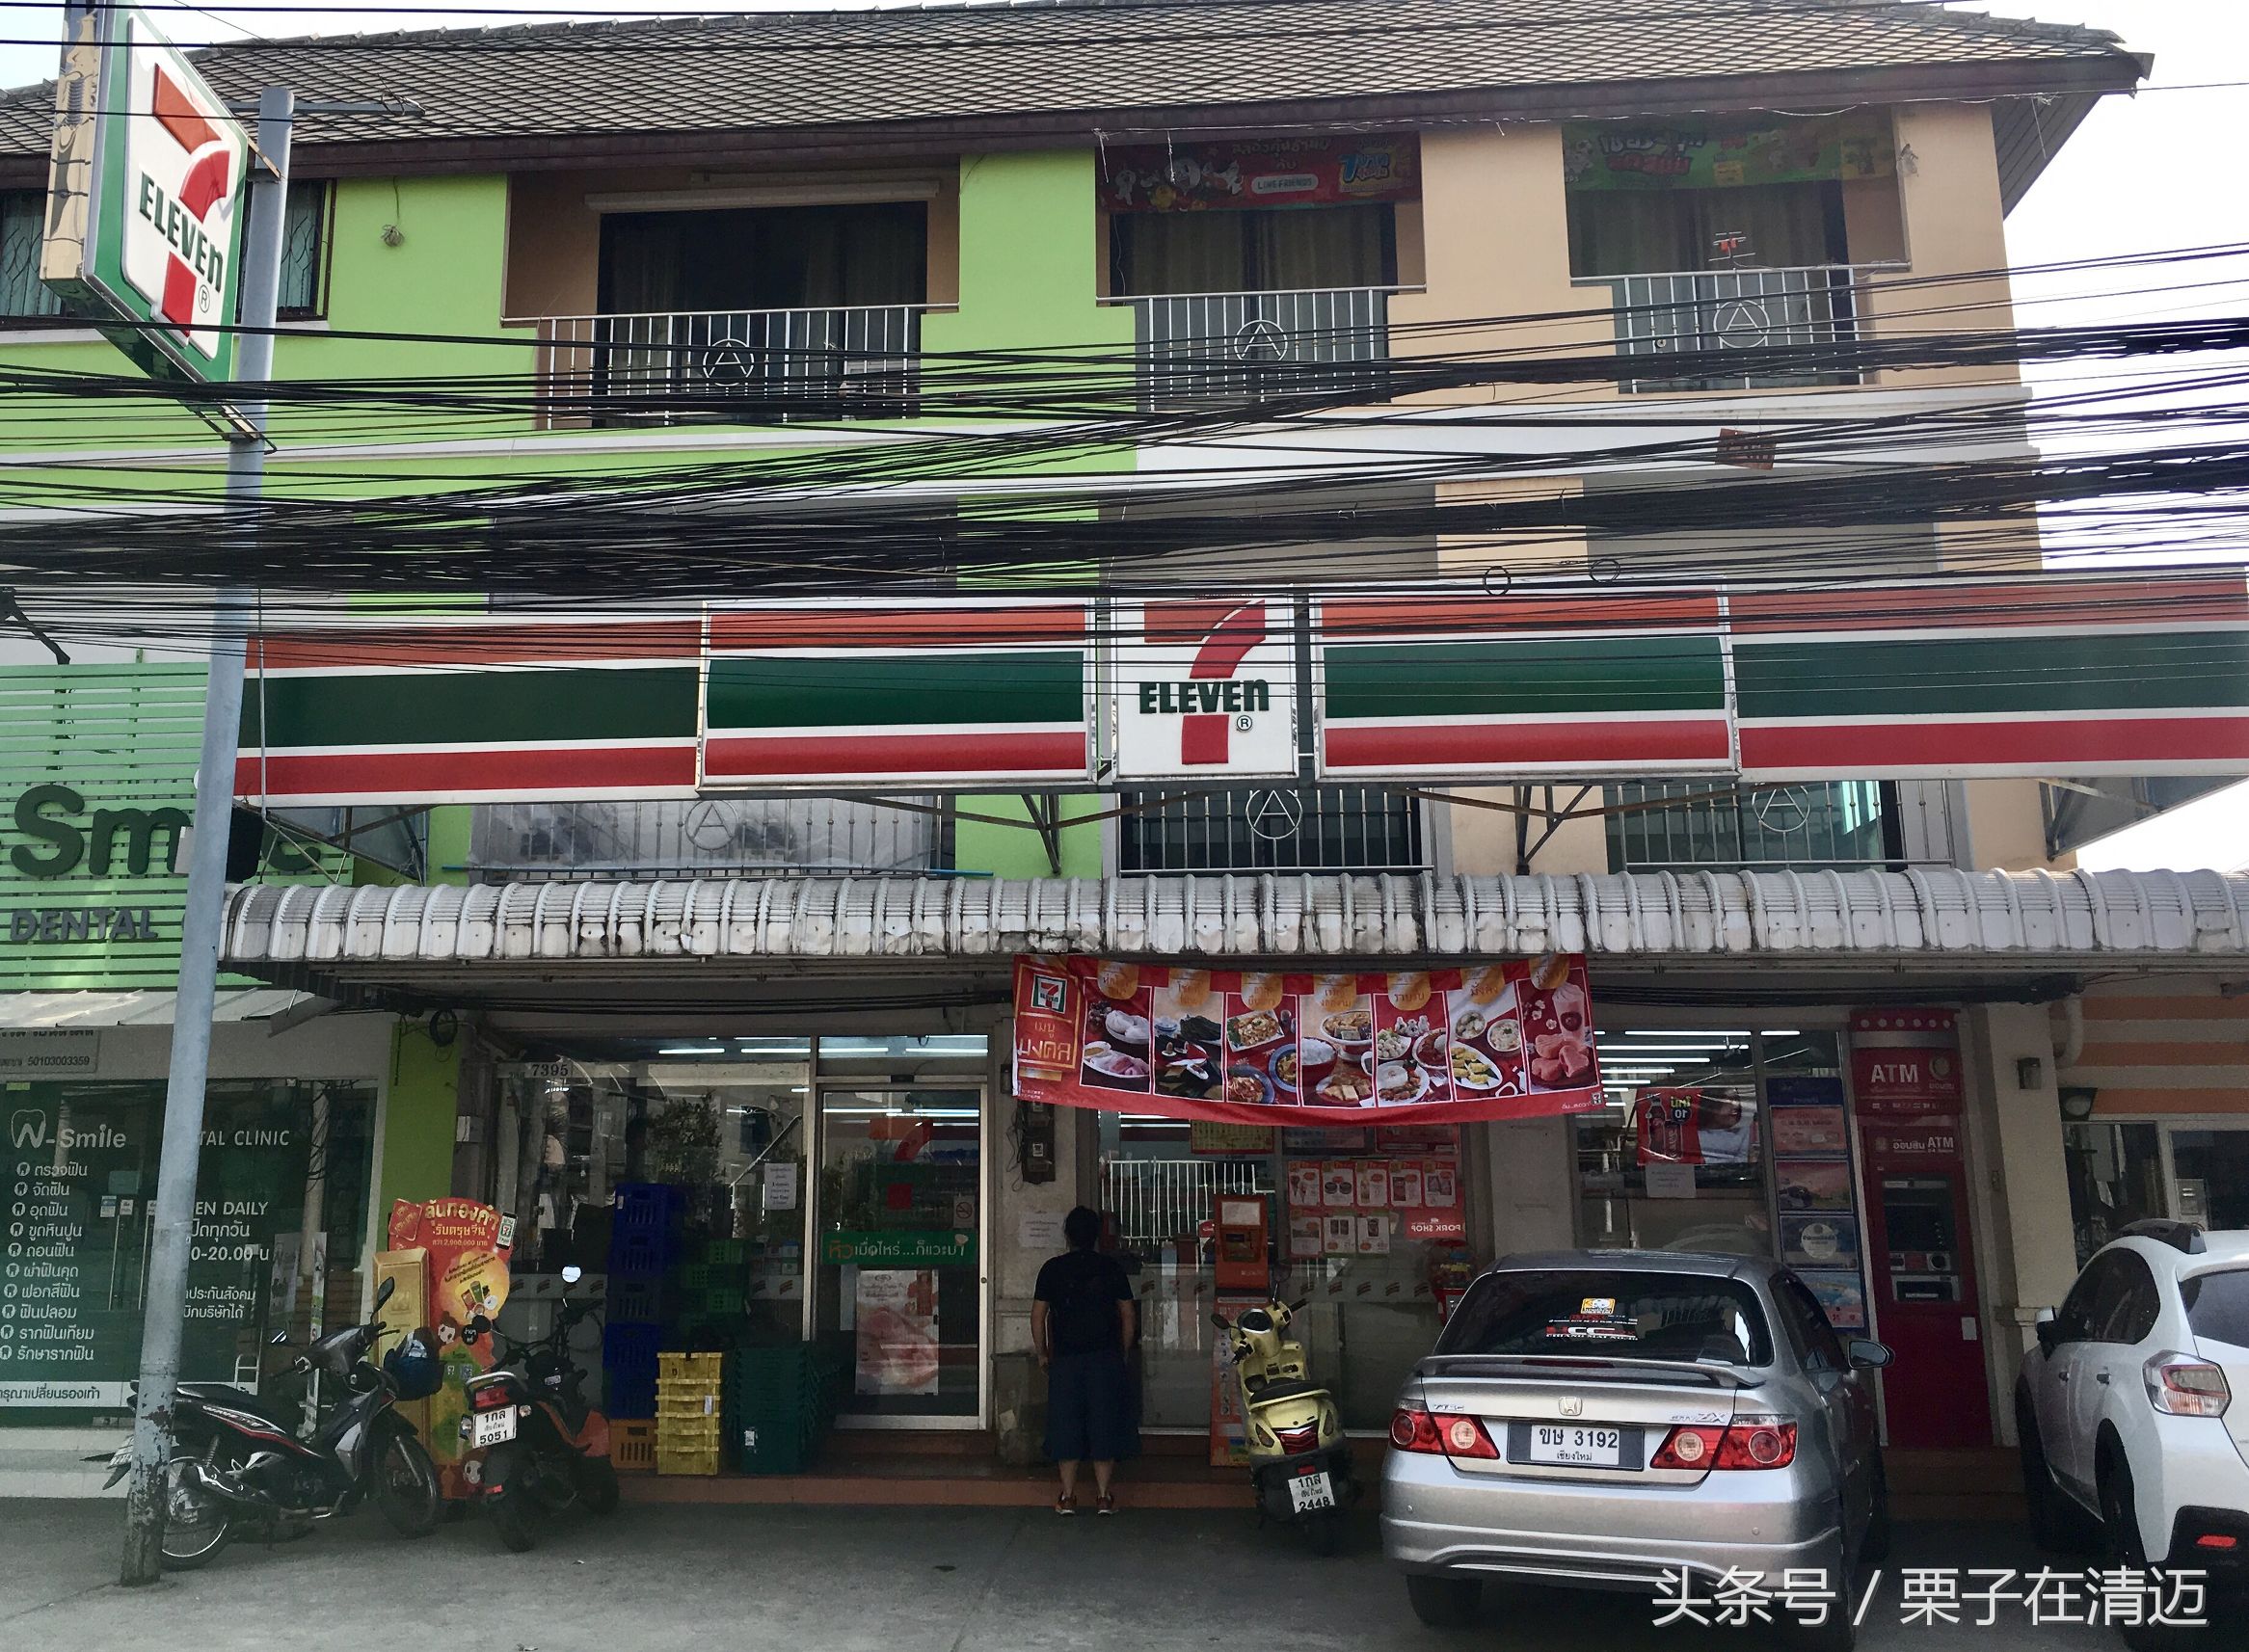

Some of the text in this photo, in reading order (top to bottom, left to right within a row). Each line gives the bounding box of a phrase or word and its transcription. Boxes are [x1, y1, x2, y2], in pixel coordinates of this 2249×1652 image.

[10, 907, 158, 943] DENTAL
[1017, 1038, 1072, 1062] มงคล
[531, 1063, 569, 1077] 7395
[1871, 1063, 1919, 1083] ATM
[200, 1131, 290, 1146] TAL CLINIC
[1928, 1135, 1955, 1149] ATM
[34, 1161, 88, 1177] ตรวจฟัน
[33, 1182, 70, 1196] จัดฟัน
[30, 1202, 68, 1220] อุดฟัน
[196, 1201, 269, 1215] EN DAILY
[28, 1222, 83, 1241] ขูดหินปูน
[191, 1217, 251, 1242] ปิดทุกวัน
[26, 1242, 75, 1258] ถอนฟัน
[191, 1246, 254, 1262] 0-20.00
[23, 1262, 79, 1282] ผ่าฟันคุด
[21, 1283, 80, 1298] ฟอกสีฟัน
[185, 1286, 256, 1302] ประกันสังคม
[19, 1304, 77, 1319] ฟันปลอม
[183, 1303, 245, 1319] บิกบริษัทได้
[19, 1324, 94, 1340] รากฟันเทียม
[17, 1346, 94, 1361] รักษารากฟัน
[479, 1429, 508, 1445] 5051
[1539, 1428, 1619, 1449] ขษ 3192
[1556, 1450, 1593, 1463] เชียงใหม่
